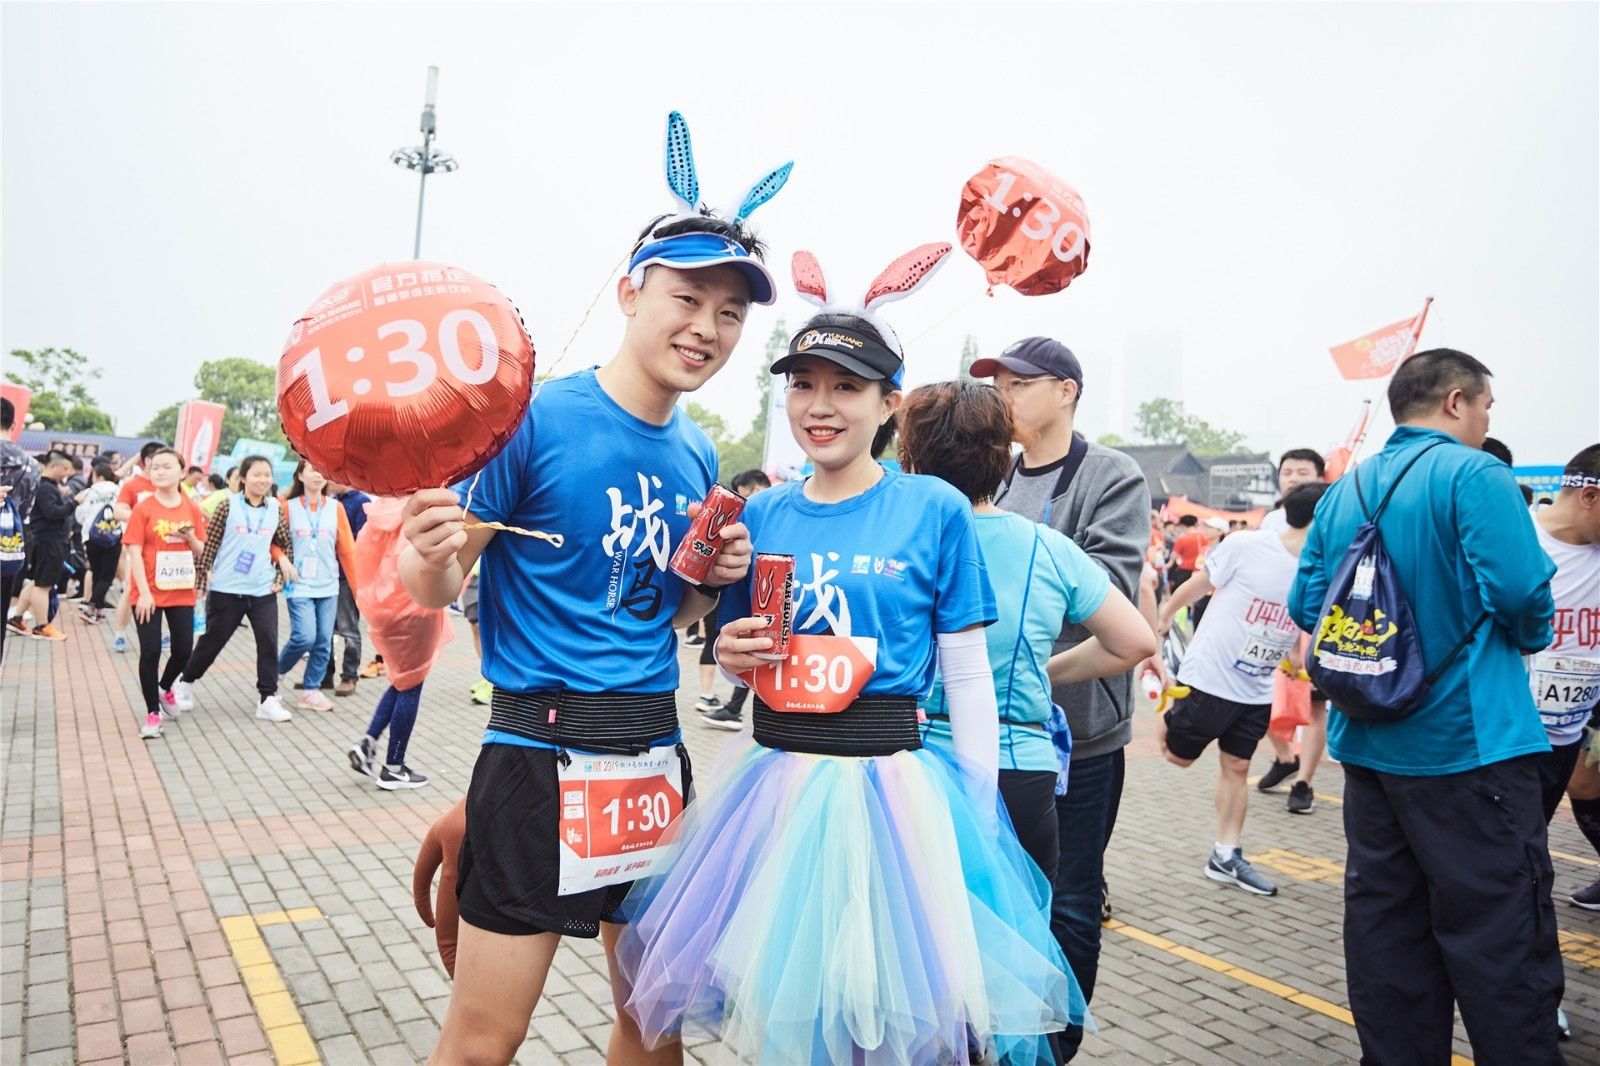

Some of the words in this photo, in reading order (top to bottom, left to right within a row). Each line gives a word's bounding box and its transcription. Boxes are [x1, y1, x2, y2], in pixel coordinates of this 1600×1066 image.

[983, 172, 1085, 263] 1:30
[293, 309, 500, 432] 1:30
[610, 551, 623, 574] WAR
[605, 576, 619, 609] HORSE
[784, 572, 794, 602] WAR
[781, 602, 791, 646] HORSE
[769, 654, 851, 695] 1:30
[602, 791, 670, 836] 1:30
